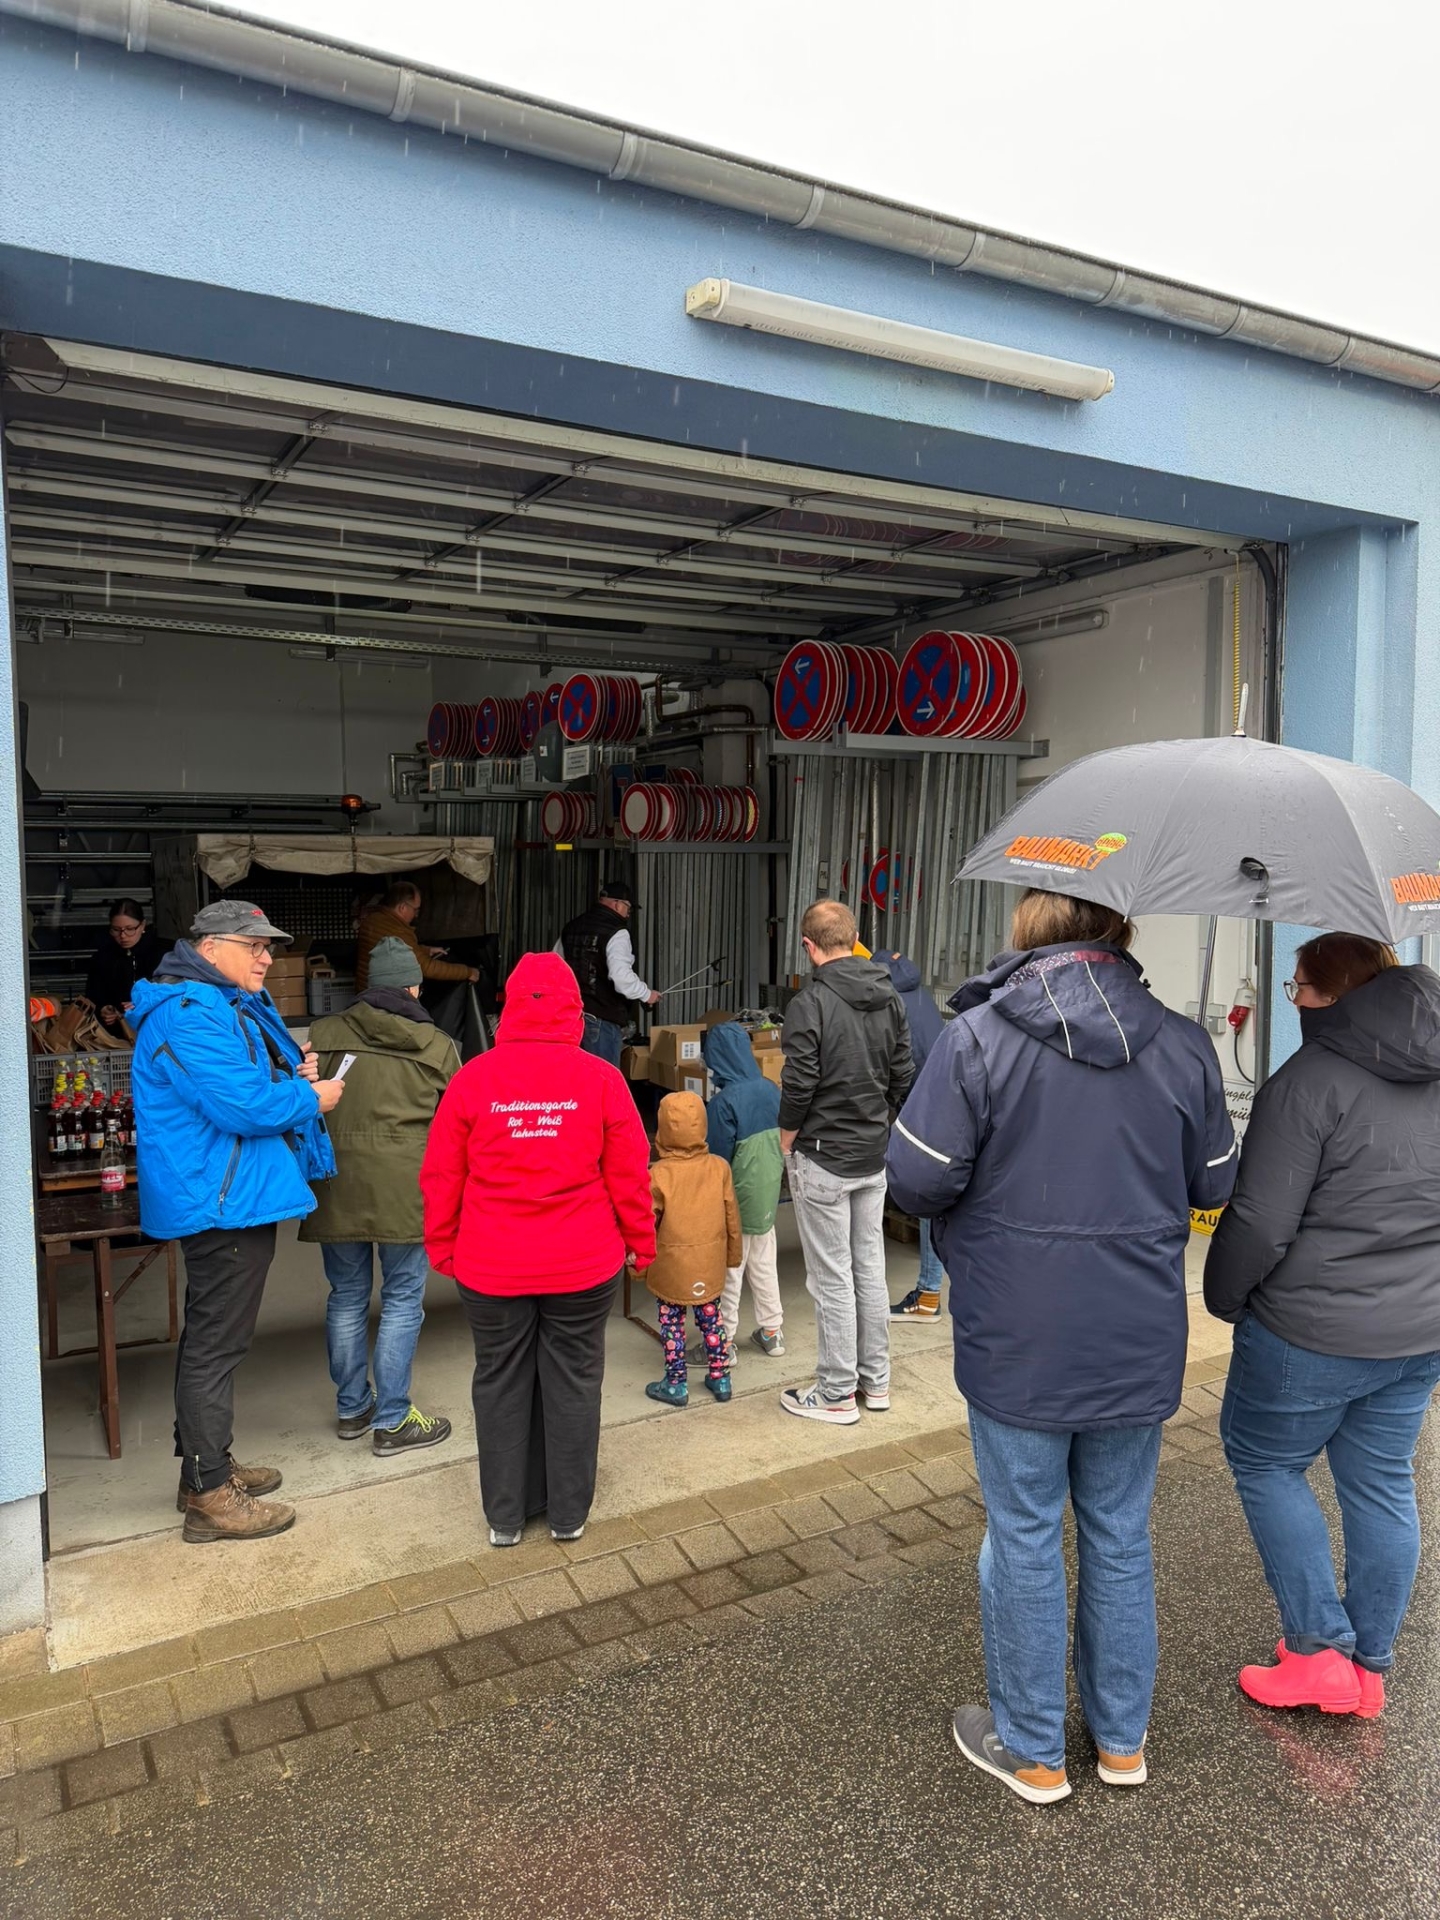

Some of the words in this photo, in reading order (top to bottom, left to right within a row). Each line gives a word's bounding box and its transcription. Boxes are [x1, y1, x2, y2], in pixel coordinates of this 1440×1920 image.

[1004, 835, 1110, 870] BAUMARKT
[490, 1099, 578, 1114] Traditionsgarde
[507, 1116, 523, 1128] Rot
[537, 1115, 563, 1126] Weiß
[511, 1128, 558, 1139] Lahnstein
